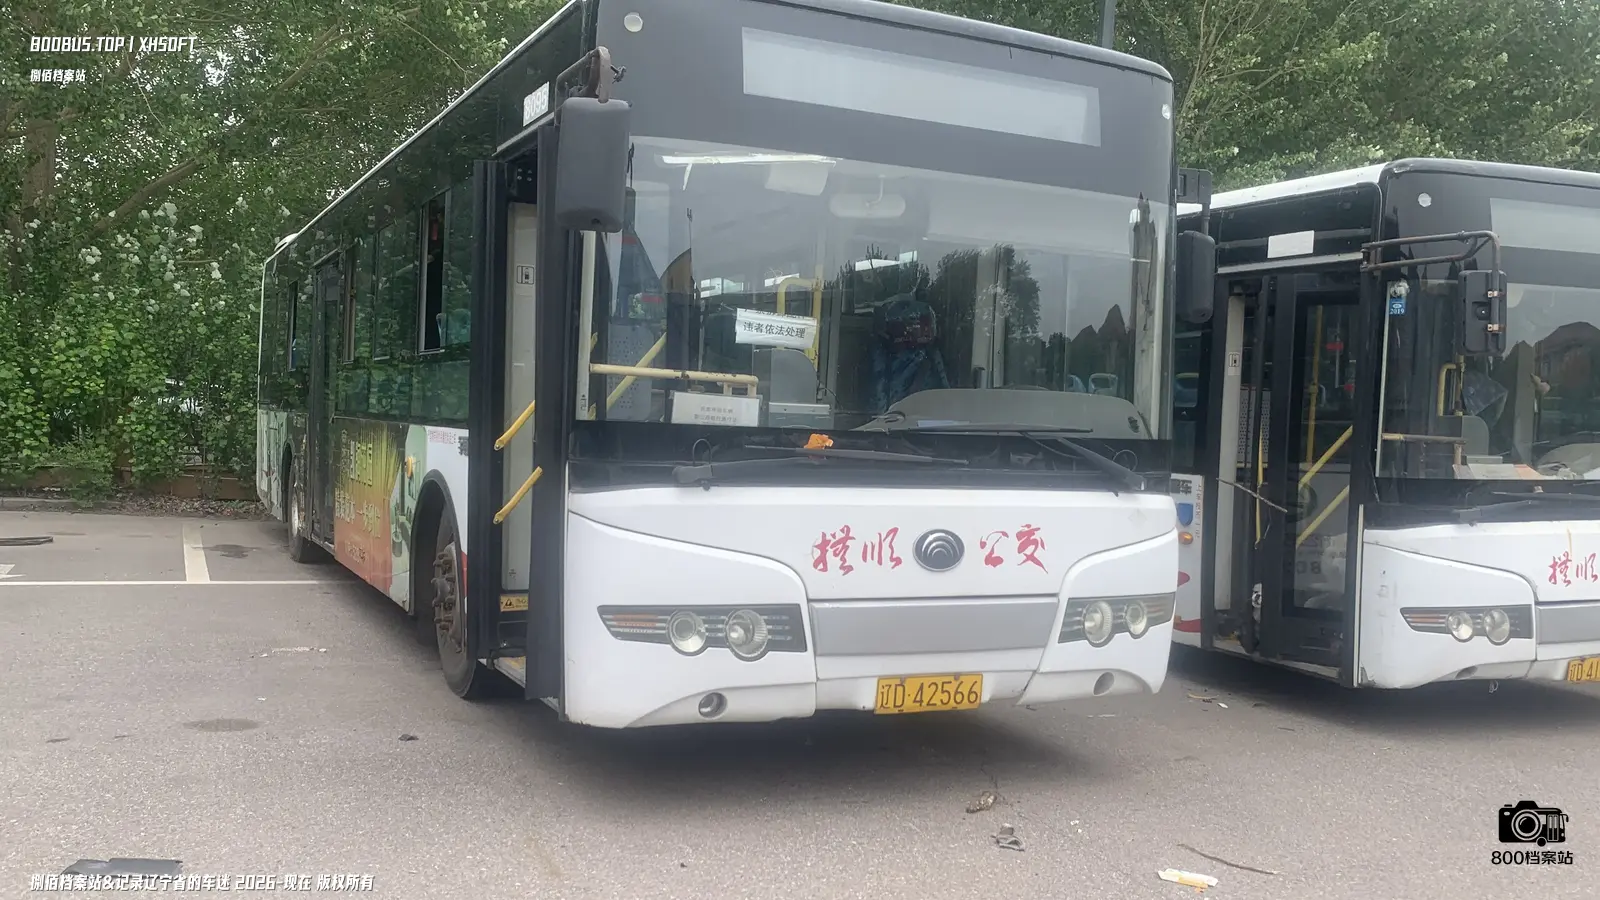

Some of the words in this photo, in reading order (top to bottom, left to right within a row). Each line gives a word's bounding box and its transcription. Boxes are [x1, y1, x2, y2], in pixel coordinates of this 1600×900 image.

[743, 321, 806, 338] 违者依法处理
[979, 523, 1049, 575] 公交
